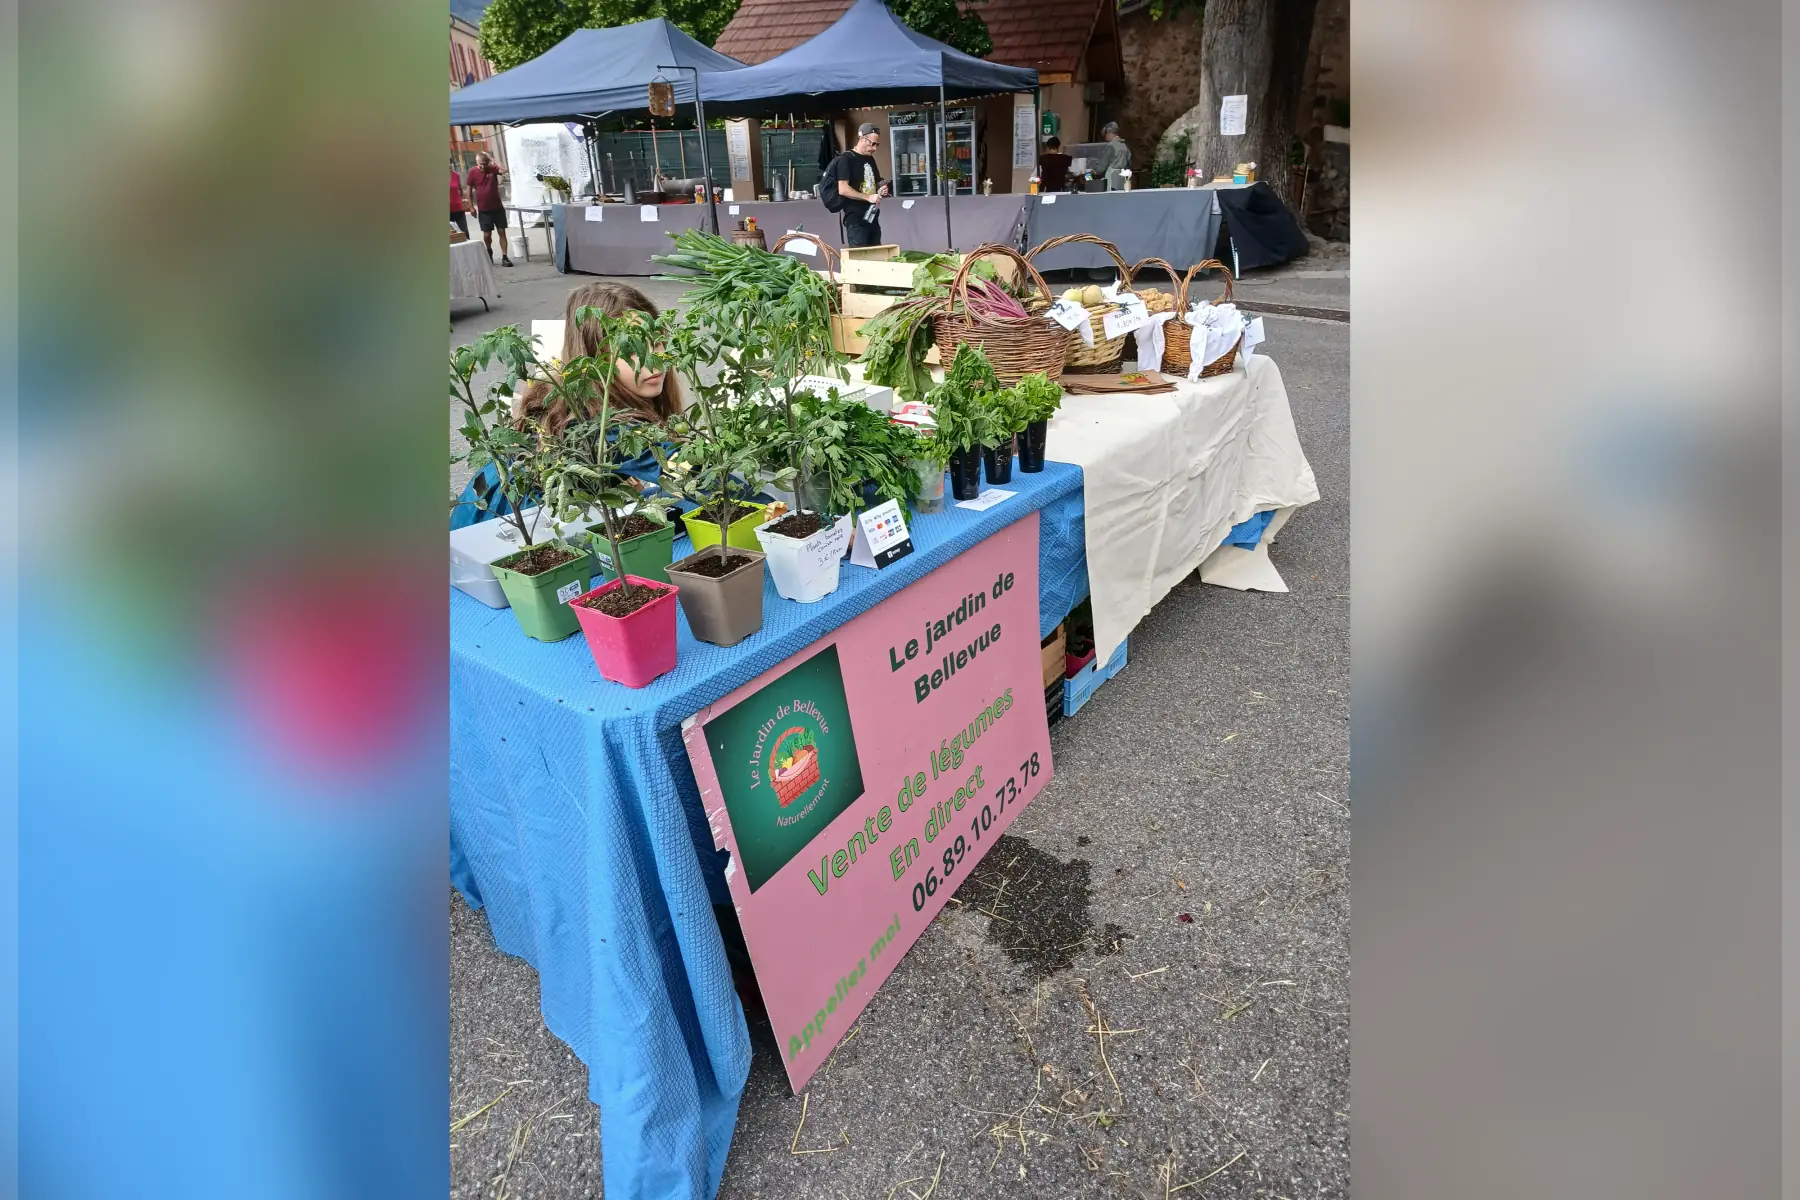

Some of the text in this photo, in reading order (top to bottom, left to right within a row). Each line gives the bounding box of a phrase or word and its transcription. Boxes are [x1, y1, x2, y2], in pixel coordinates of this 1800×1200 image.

[889, 572, 1014, 673] Le jardin de
[914, 623, 1001, 704] Bellevue
[749, 699, 829, 791] Le Jardin de Bellevue
[807, 687, 1014, 896] Vente de légumes
[776, 778, 830, 827] Naturellement
[889, 765, 985, 881] En direct
[912, 752, 1040, 912] 06.89.10.73.78
[788, 912, 901, 1063] Appellez moi
